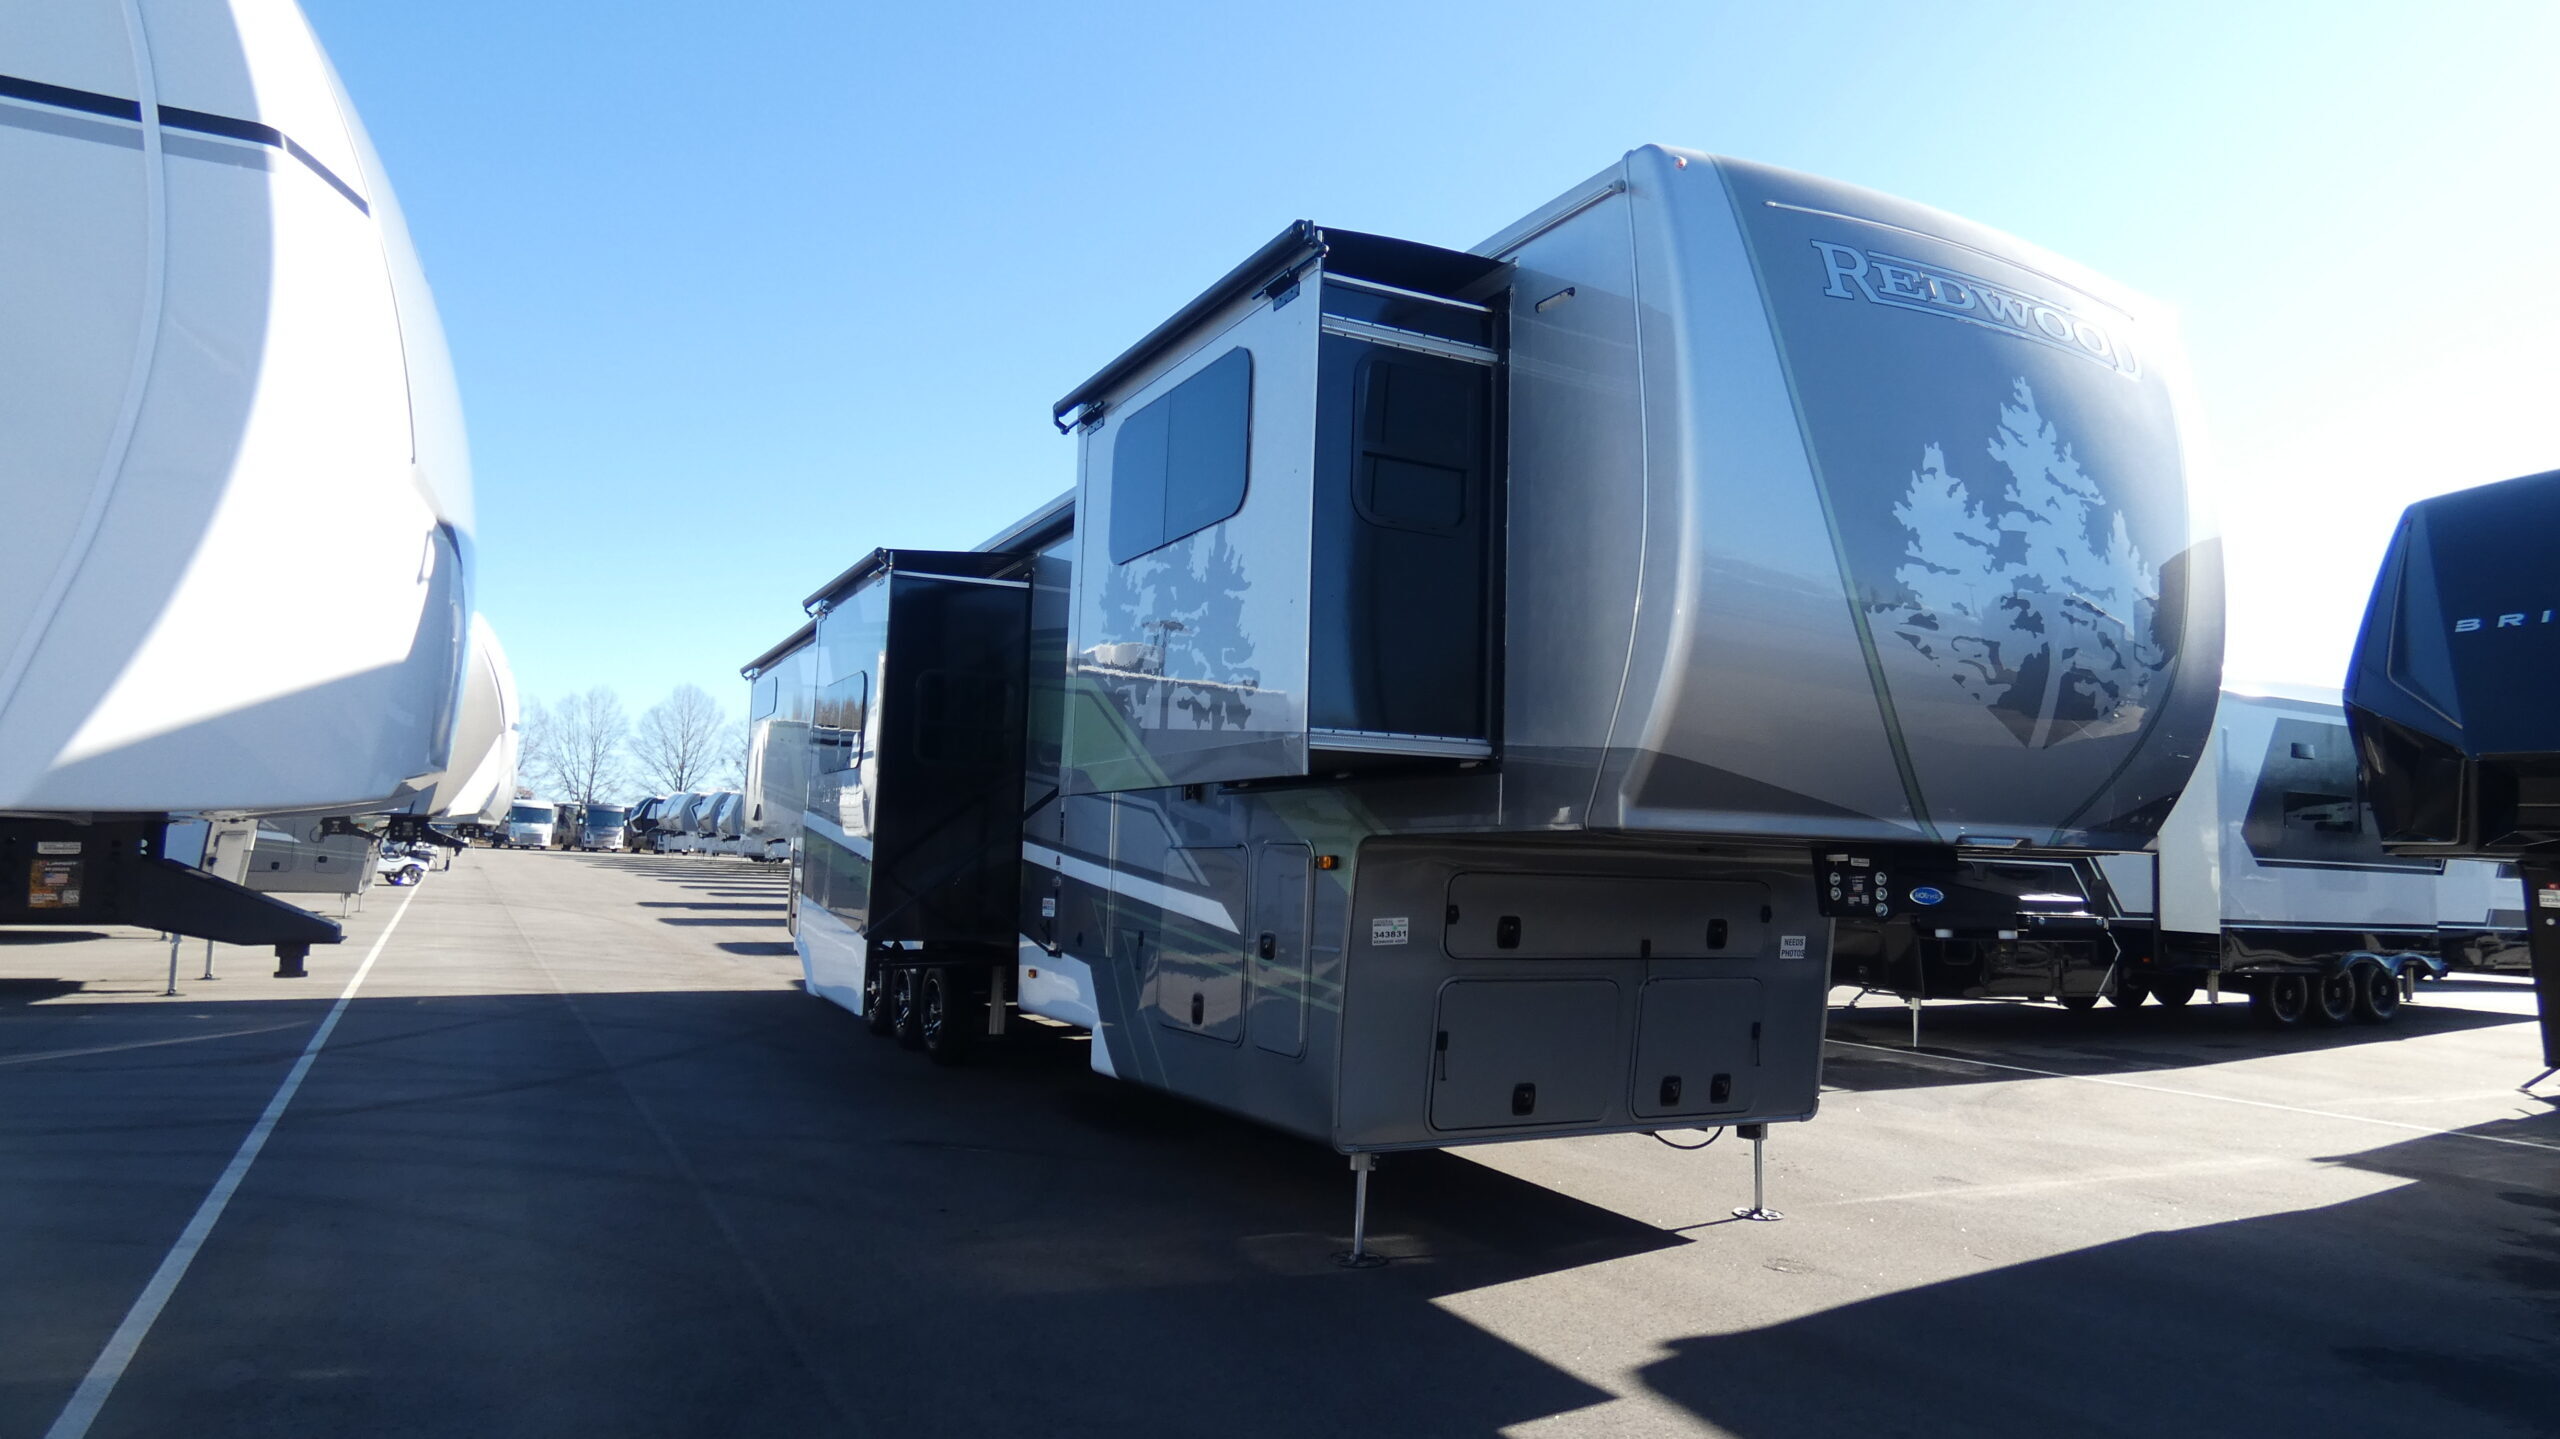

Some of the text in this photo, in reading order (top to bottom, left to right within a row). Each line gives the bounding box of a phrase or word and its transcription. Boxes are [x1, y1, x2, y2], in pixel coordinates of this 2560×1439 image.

[1809, 238, 2143, 382] REDWOOD
[2454, 610, 2552, 633] BRI
[1373, 930, 1407, 939] 343831
[1784, 938, 1804, 947] NEEDS
[1781, 949, 1805, 958] PHOTOS
